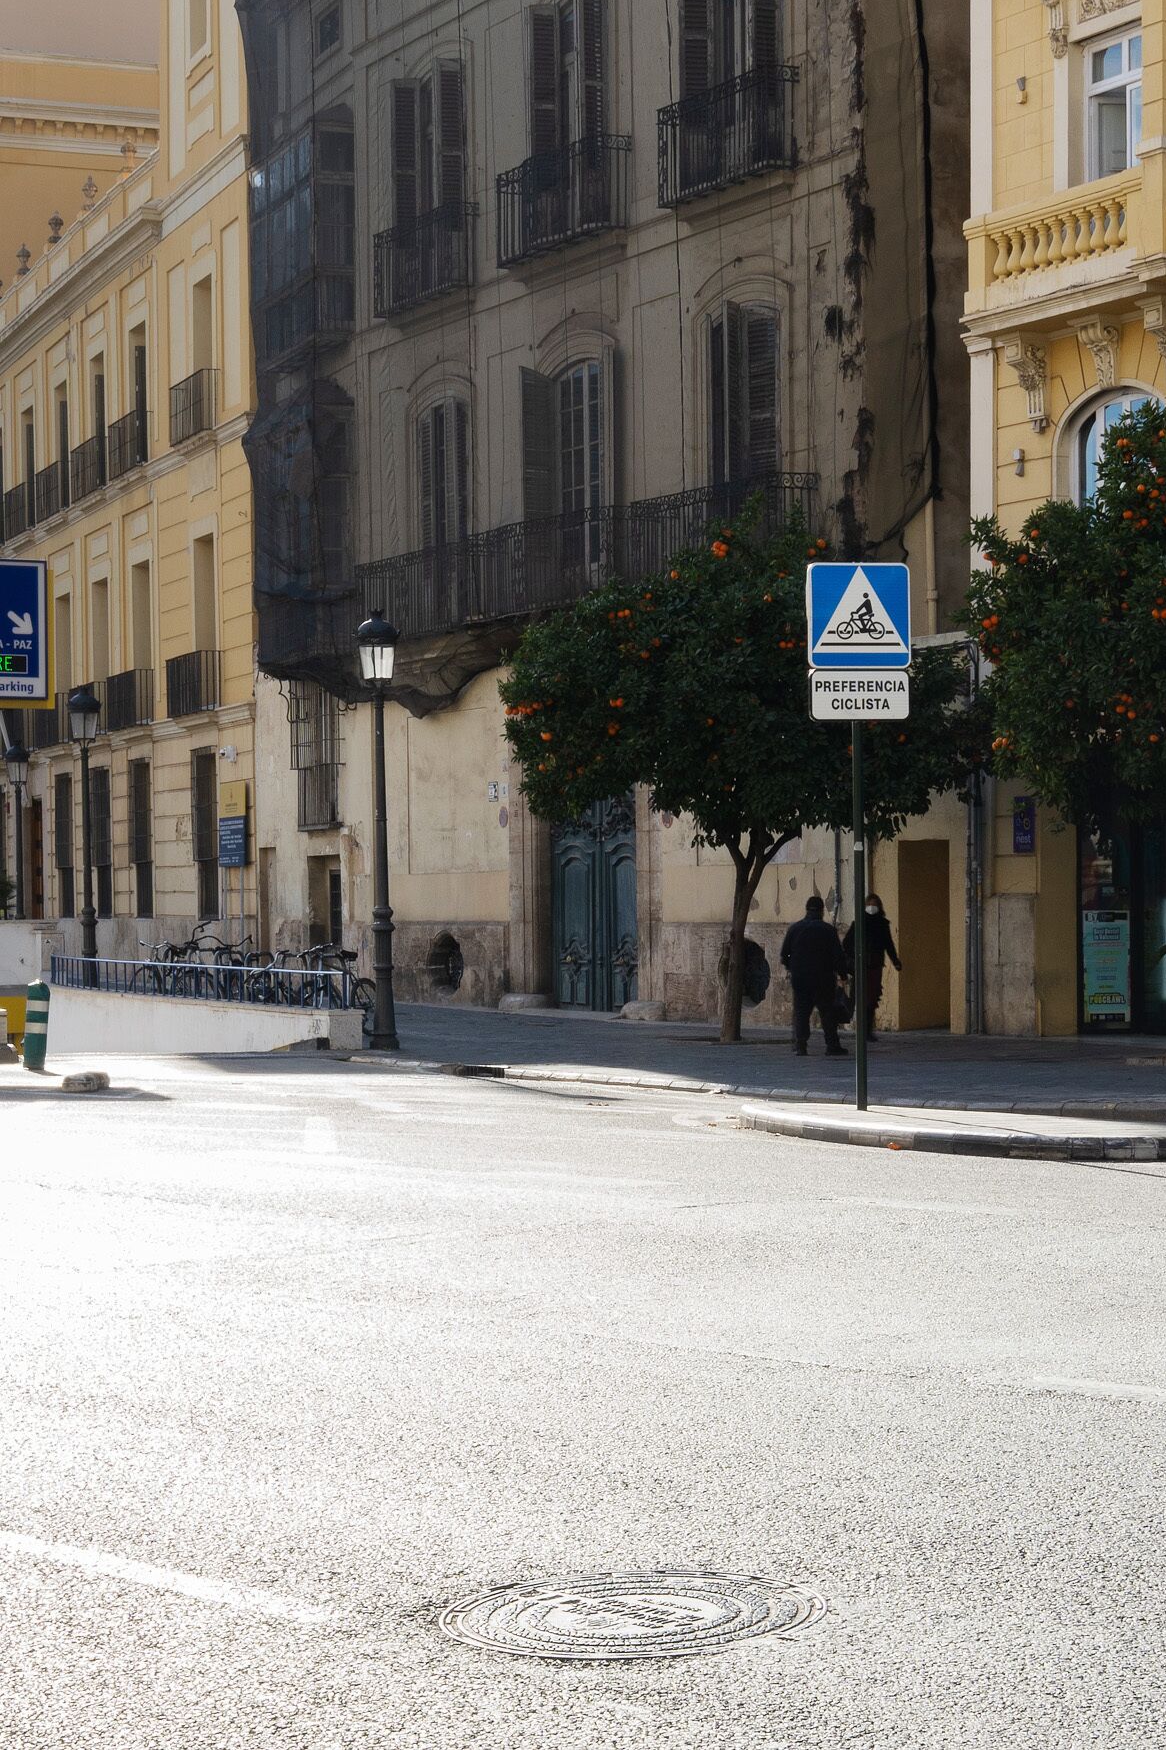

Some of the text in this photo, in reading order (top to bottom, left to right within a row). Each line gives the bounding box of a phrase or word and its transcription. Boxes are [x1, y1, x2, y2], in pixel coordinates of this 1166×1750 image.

[13, 639, 32, 649] PAZ
[815, 680, 906, 693] PREFERENCIA
[831, 698, 890, 710] CICLISTA
